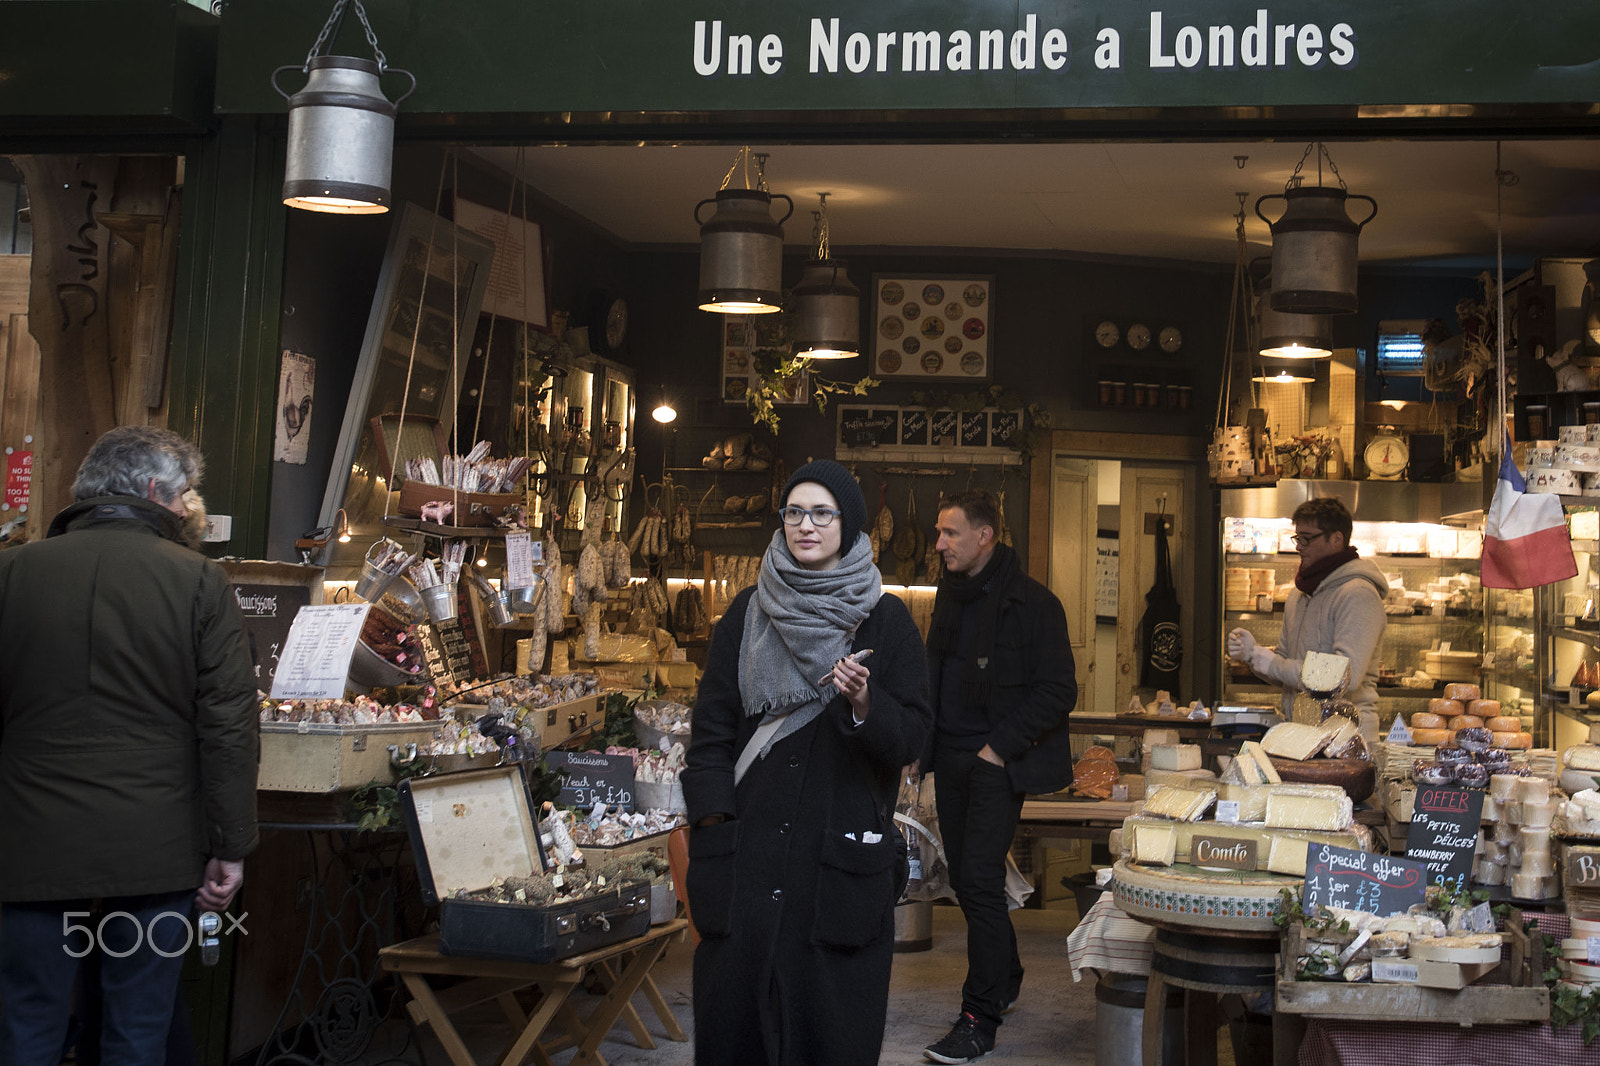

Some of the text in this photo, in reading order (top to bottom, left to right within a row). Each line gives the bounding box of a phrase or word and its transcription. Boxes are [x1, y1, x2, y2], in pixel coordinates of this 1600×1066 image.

[693, 9, 1355, 76] Une Normande a Londres
[12, 467, 23, 475] NO
[567, 752, 609, 767] Saucissons
[575, 789, 585, 803] 3
[606, 786, 631, 804] £10
[1421, 789, 1470, 810] OFFER
[1318, 845, 1405, 882] Special offer
[1308, 875, 1322, 891] 1
[1328, 877, 1350, 897] for
